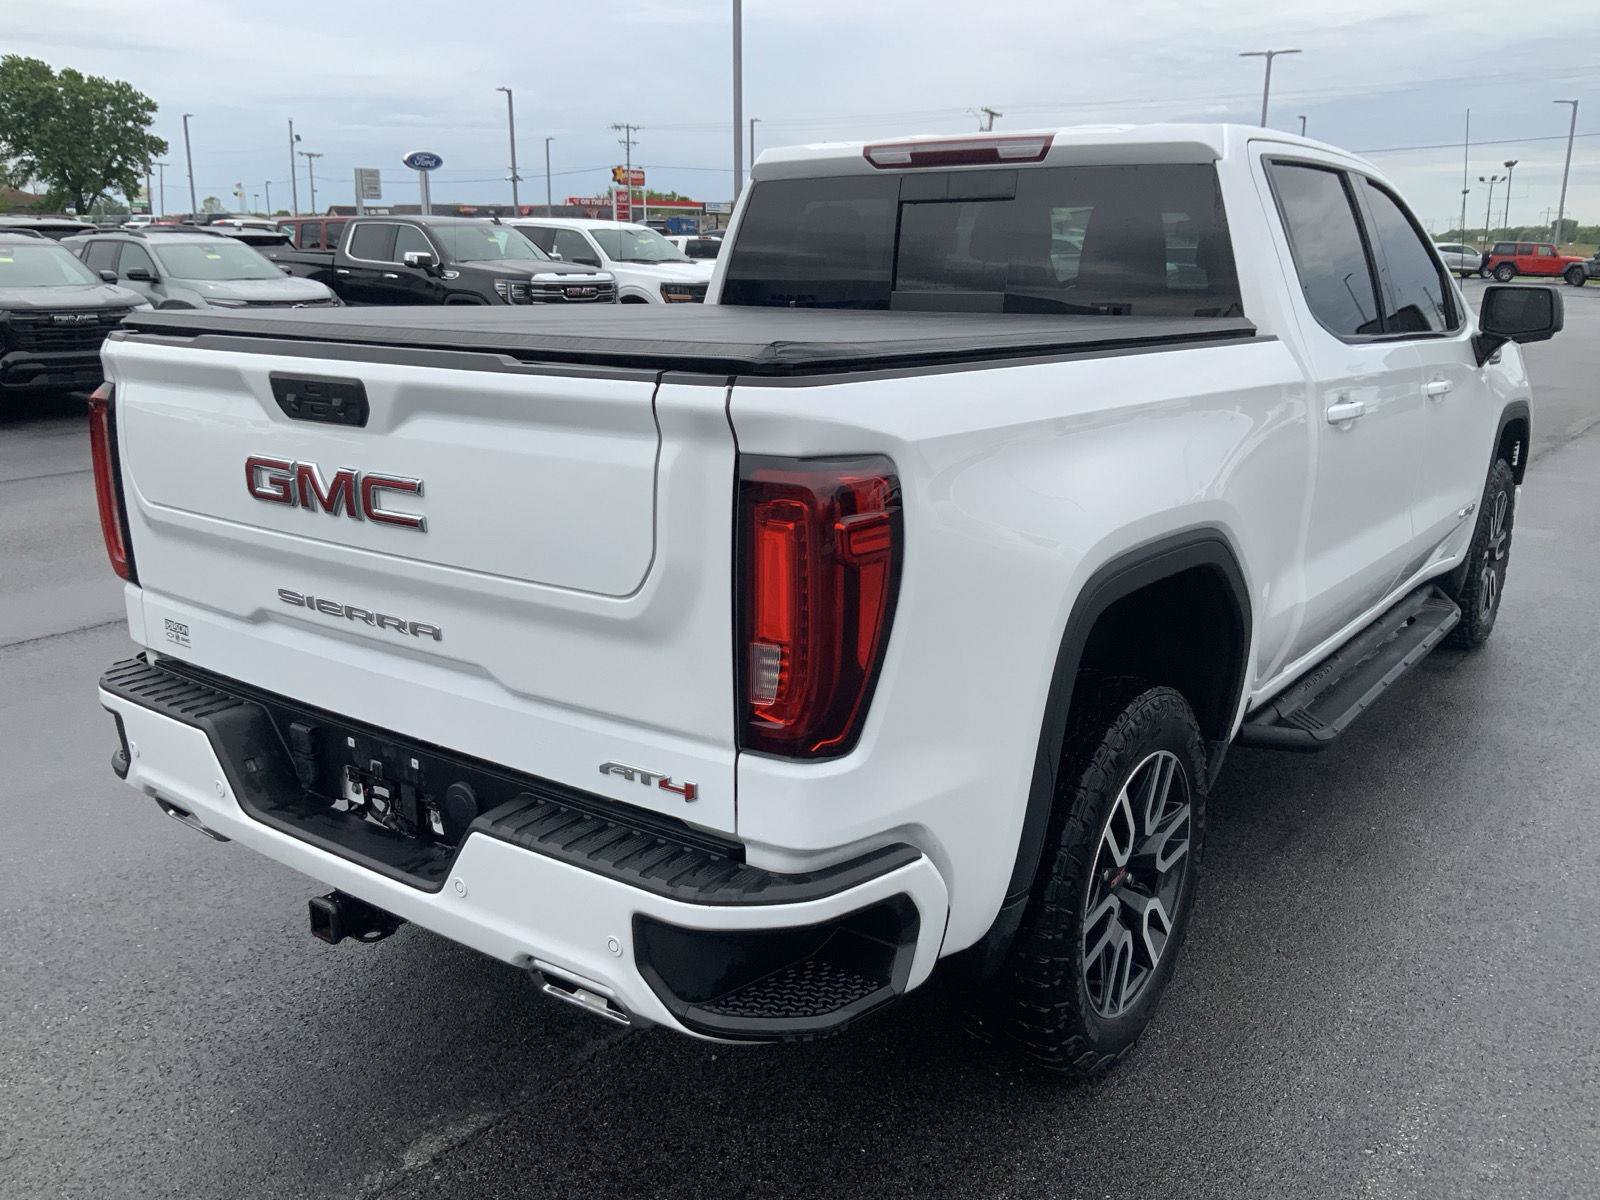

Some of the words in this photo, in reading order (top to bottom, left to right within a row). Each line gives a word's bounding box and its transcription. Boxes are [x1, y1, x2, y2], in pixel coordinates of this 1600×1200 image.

[580, 198, 591, 206] ON
[245, 453, 428, 533] GMC
[277, 588, 443, 641] SIERRA
[599, 761, 698, 802] AT4
